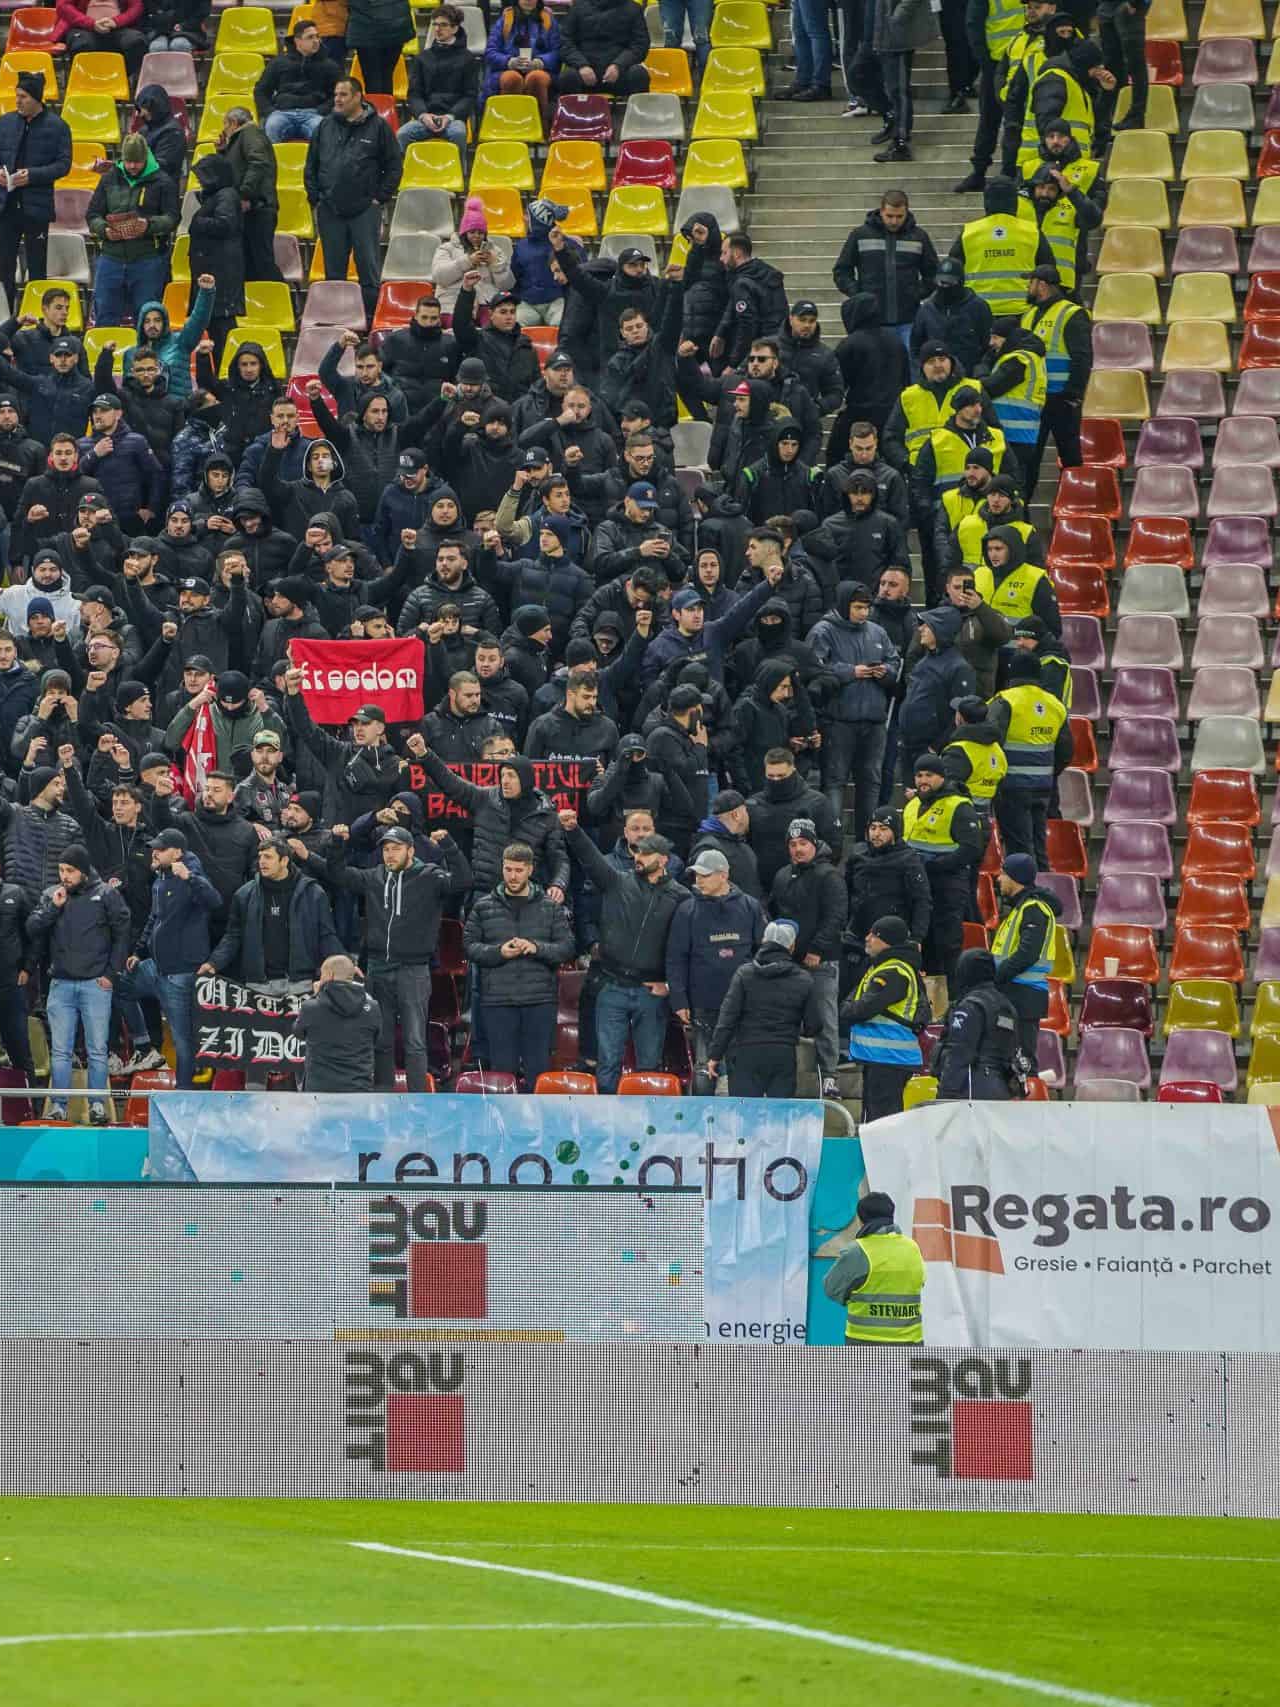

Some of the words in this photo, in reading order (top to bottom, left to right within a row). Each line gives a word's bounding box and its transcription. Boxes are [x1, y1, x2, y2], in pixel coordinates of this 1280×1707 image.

[950, 1184, 1272, 1247] Regata.ro
[1013, 1255, 1078, 1273] Gresie
[1192, 1257, 1272, 1276] Parchet
[718, 1317, 806, 1345] energie
